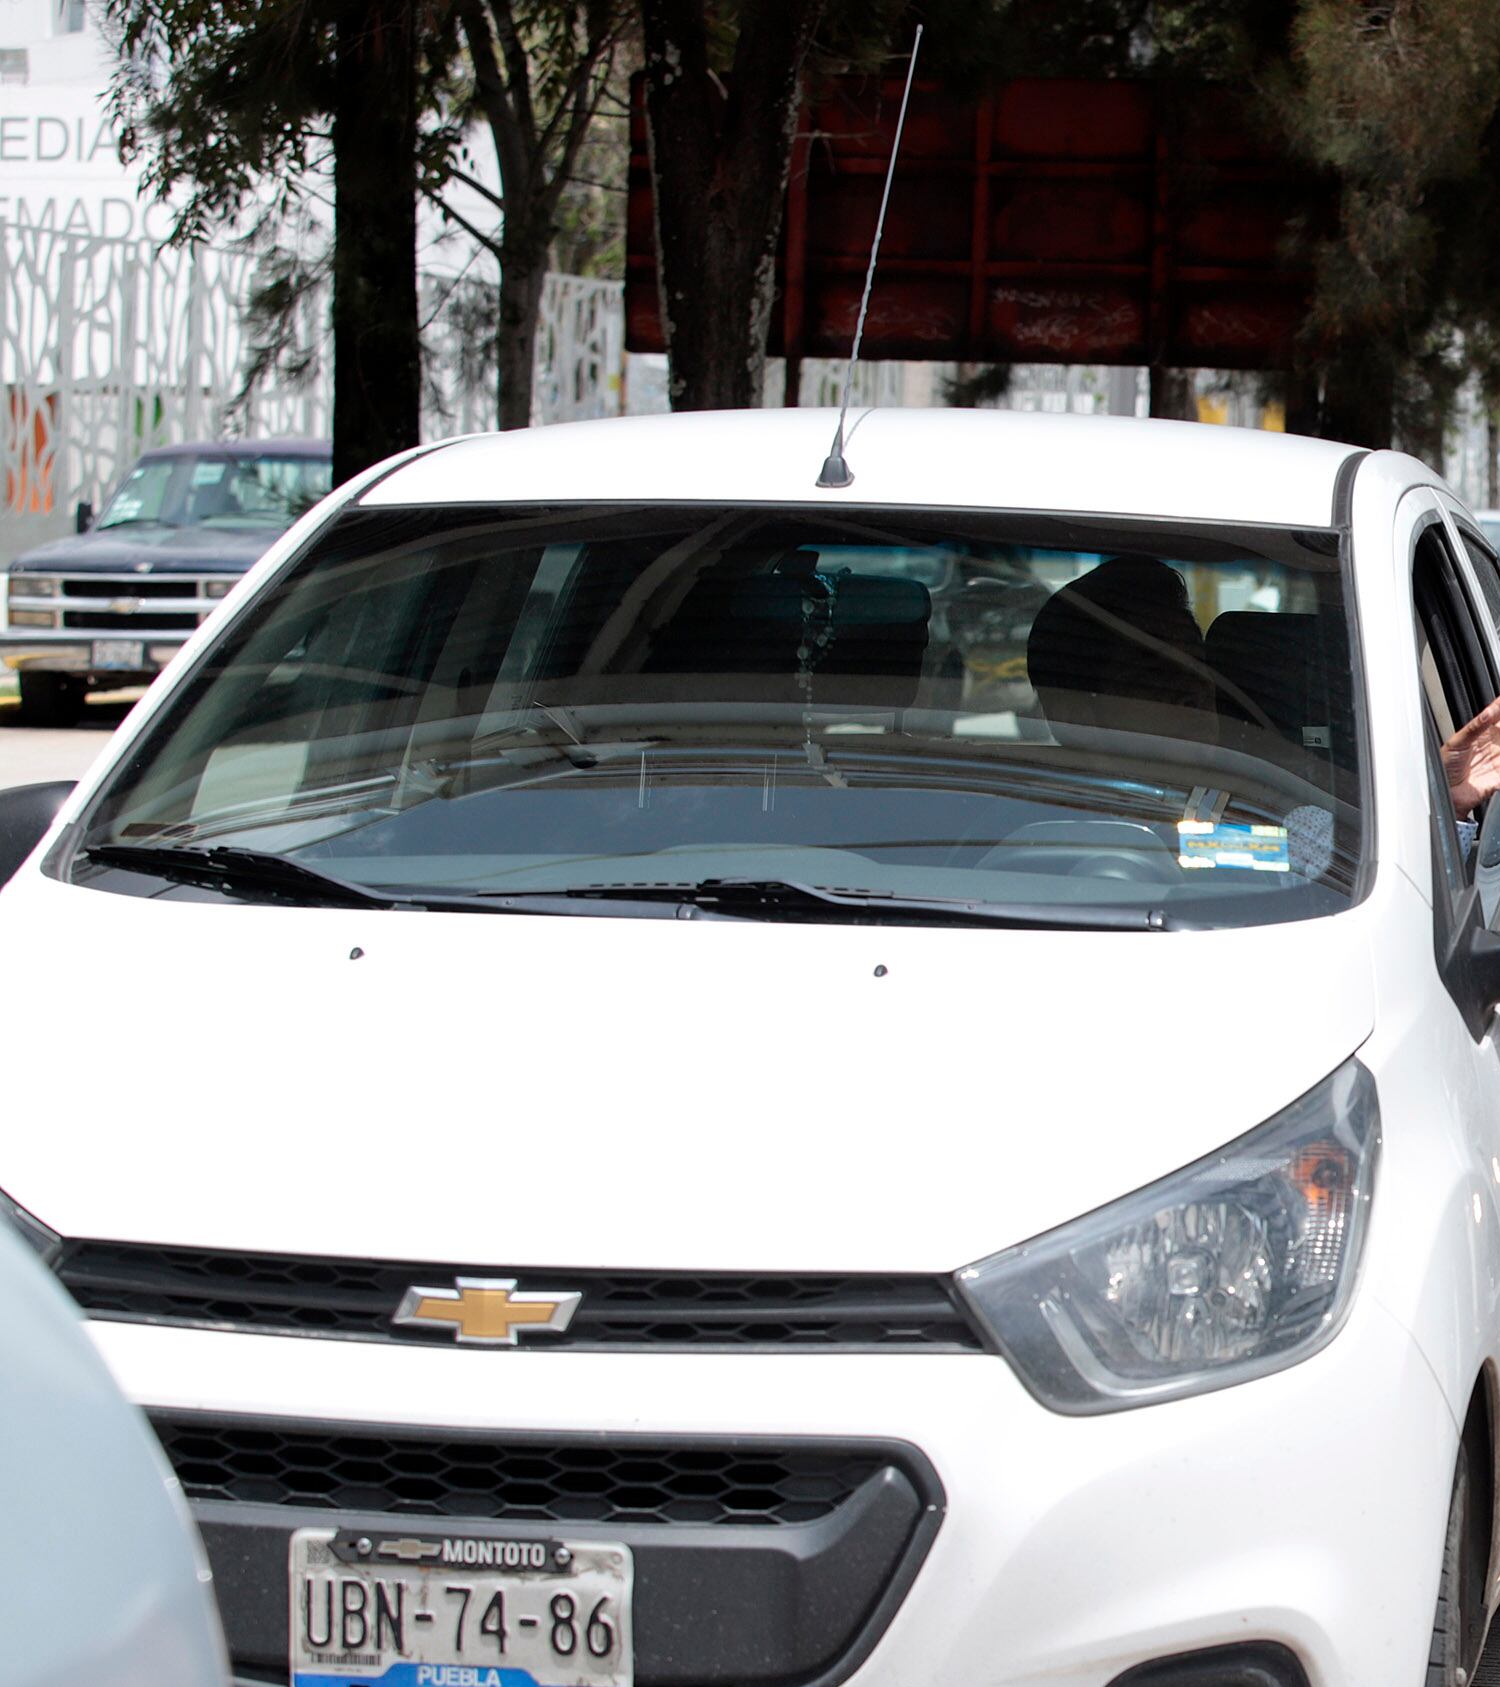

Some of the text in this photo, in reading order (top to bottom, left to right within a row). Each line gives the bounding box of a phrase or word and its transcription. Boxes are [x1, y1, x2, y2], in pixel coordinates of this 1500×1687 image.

[442, 1538, 546, 1567] MONTOTO
[306, 1578, 613, 1658] UBN-74-86
[417, 1665, 502, 1687] PUEBLA
